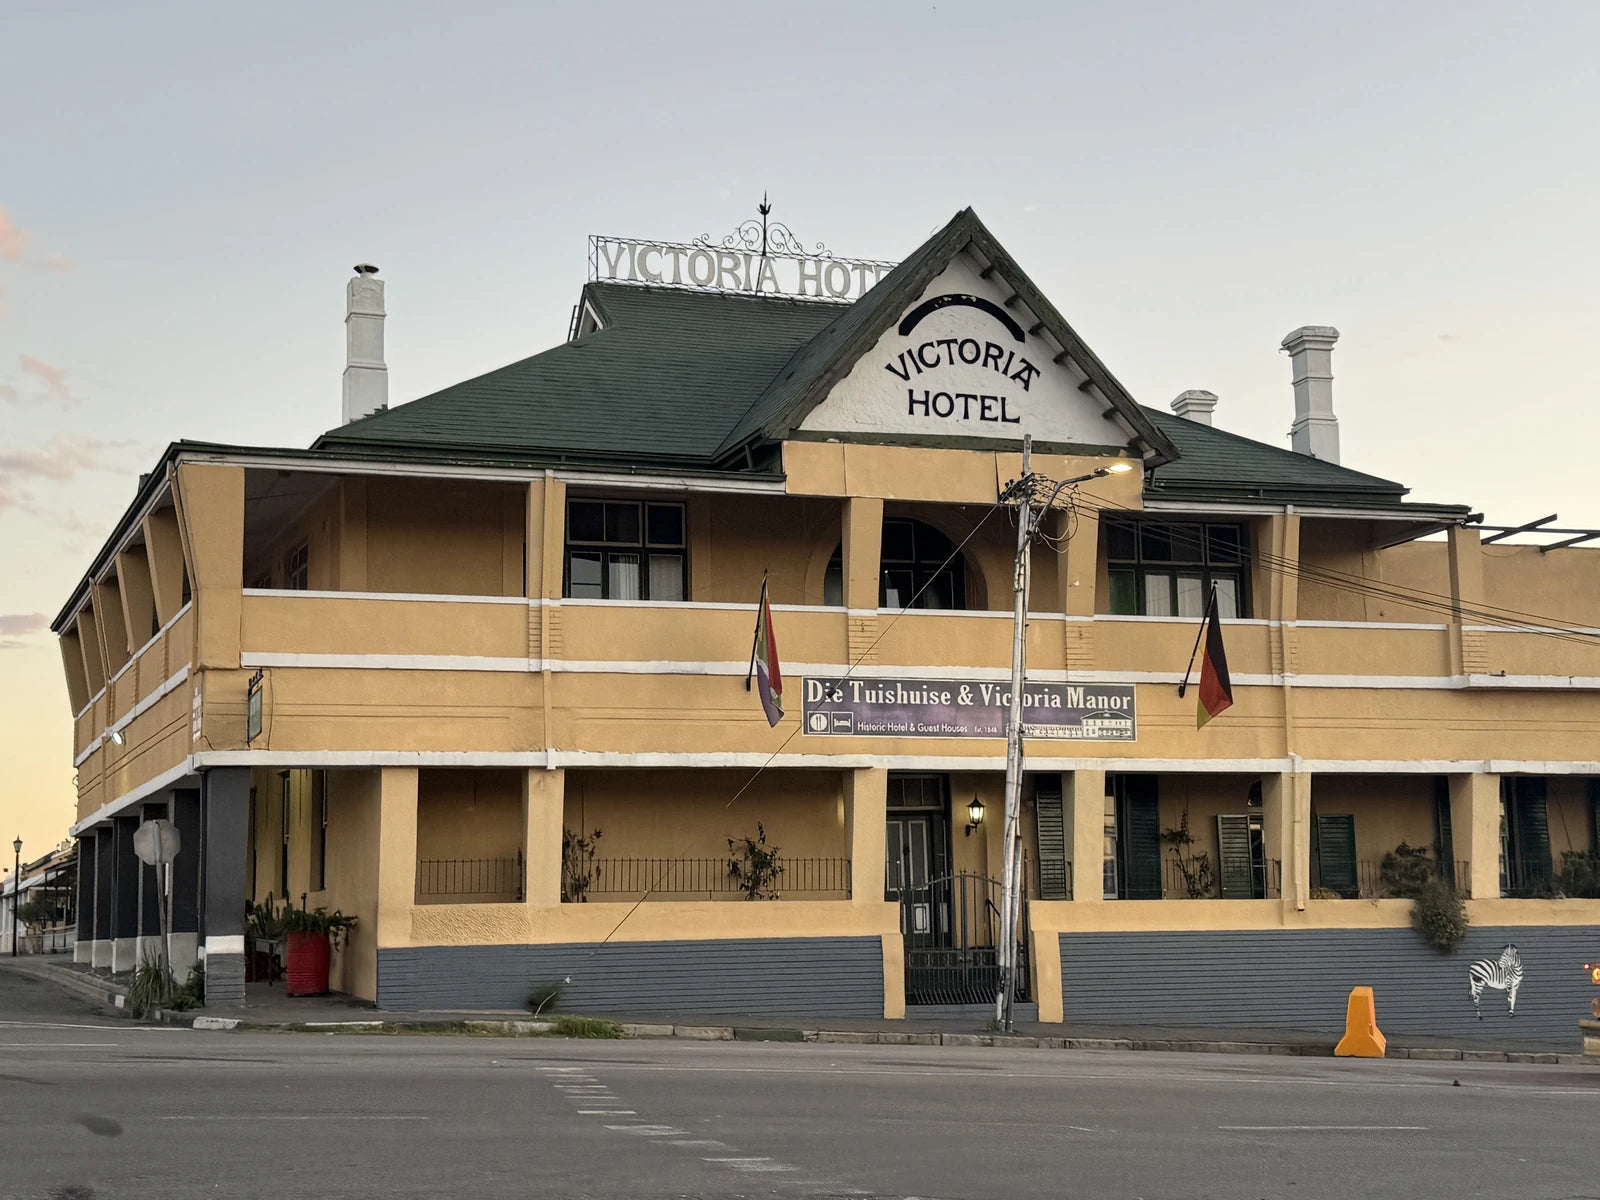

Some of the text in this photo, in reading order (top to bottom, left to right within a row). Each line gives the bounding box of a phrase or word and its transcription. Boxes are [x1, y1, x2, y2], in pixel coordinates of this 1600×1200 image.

[600, 243, 892, 299] VICTORIA HOT
[885, 338, 1041, 392] VICTORIA
[908, 389, 1020, 423] HOTEL
[807, 680, 1131, 710] Die Tuishuise & Vicoria Manor
[857, 722, 886, 731] Historic
[887, 722, 908, 732] Hotel
[909, 723, 916, 732] &
[917, 723, 940, 732] Guest
[941, 724, 968, 733] Houses
